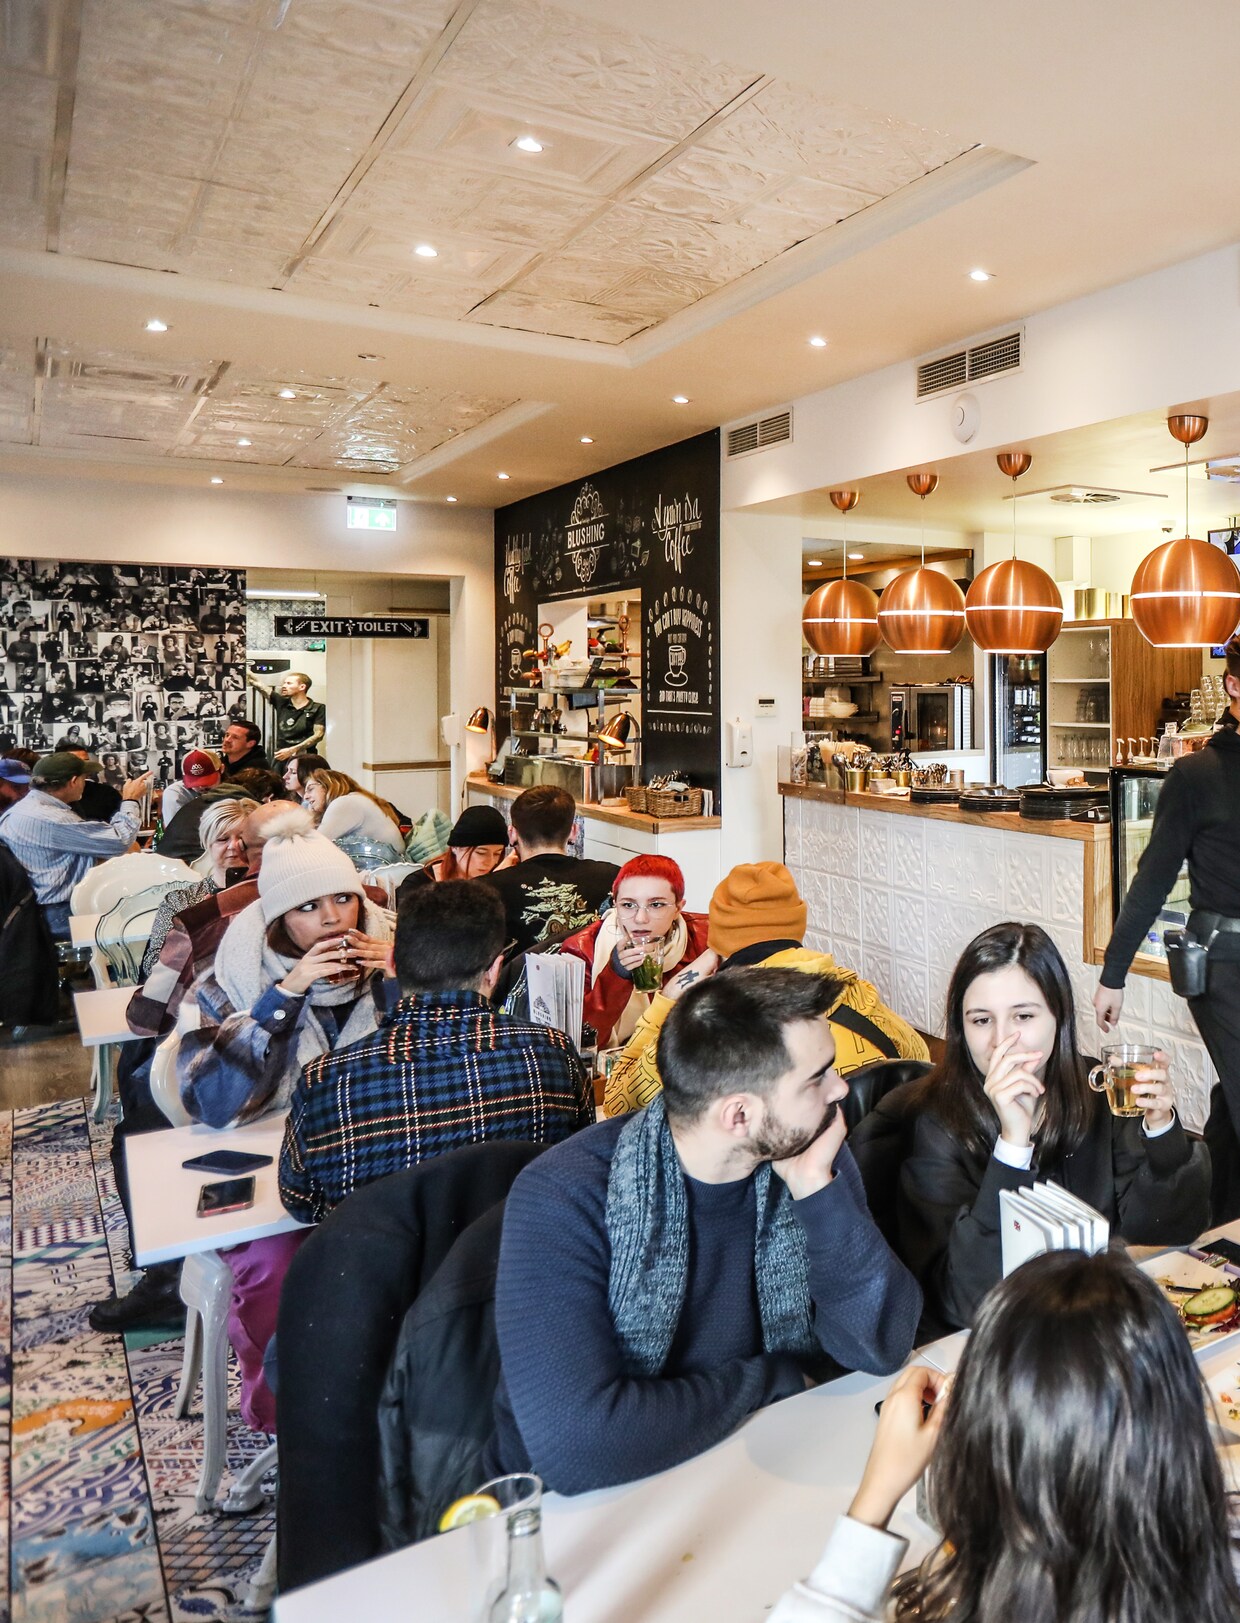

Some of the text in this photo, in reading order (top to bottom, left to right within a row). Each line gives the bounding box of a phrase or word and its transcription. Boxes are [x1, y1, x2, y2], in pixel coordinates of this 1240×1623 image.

[567, 522, 605, 549] BLUSHING
[665, 524, 694, 574] Coffee
[310, 621, 398, 633] EXIT TOILET
